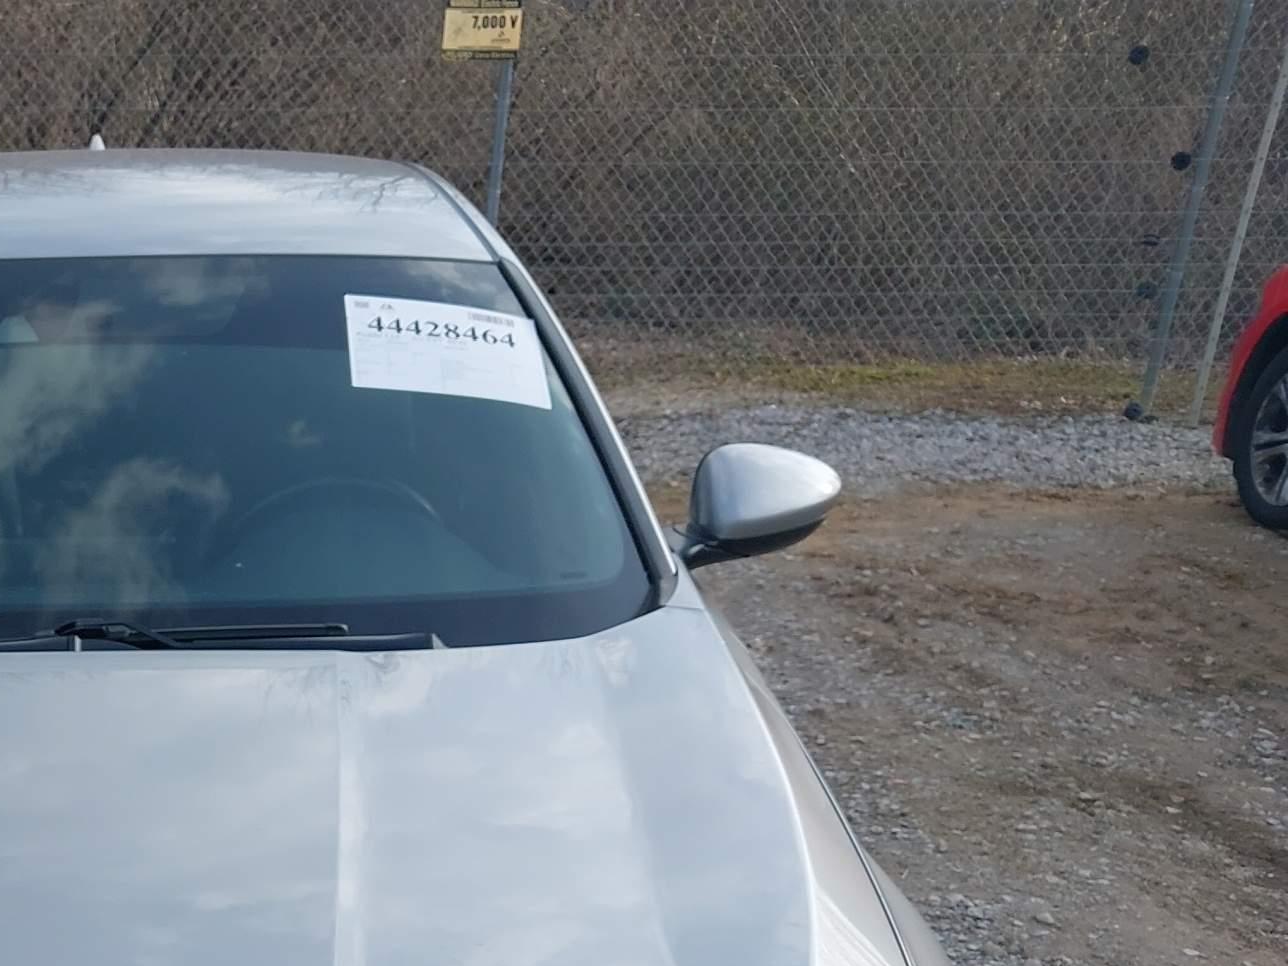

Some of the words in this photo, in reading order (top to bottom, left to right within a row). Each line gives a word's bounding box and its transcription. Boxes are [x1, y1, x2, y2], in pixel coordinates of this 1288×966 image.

[471, 14, 506, 31] 7,000
[510, 14, 519, 29] V
[367, 315, 516, 349] 44428464
